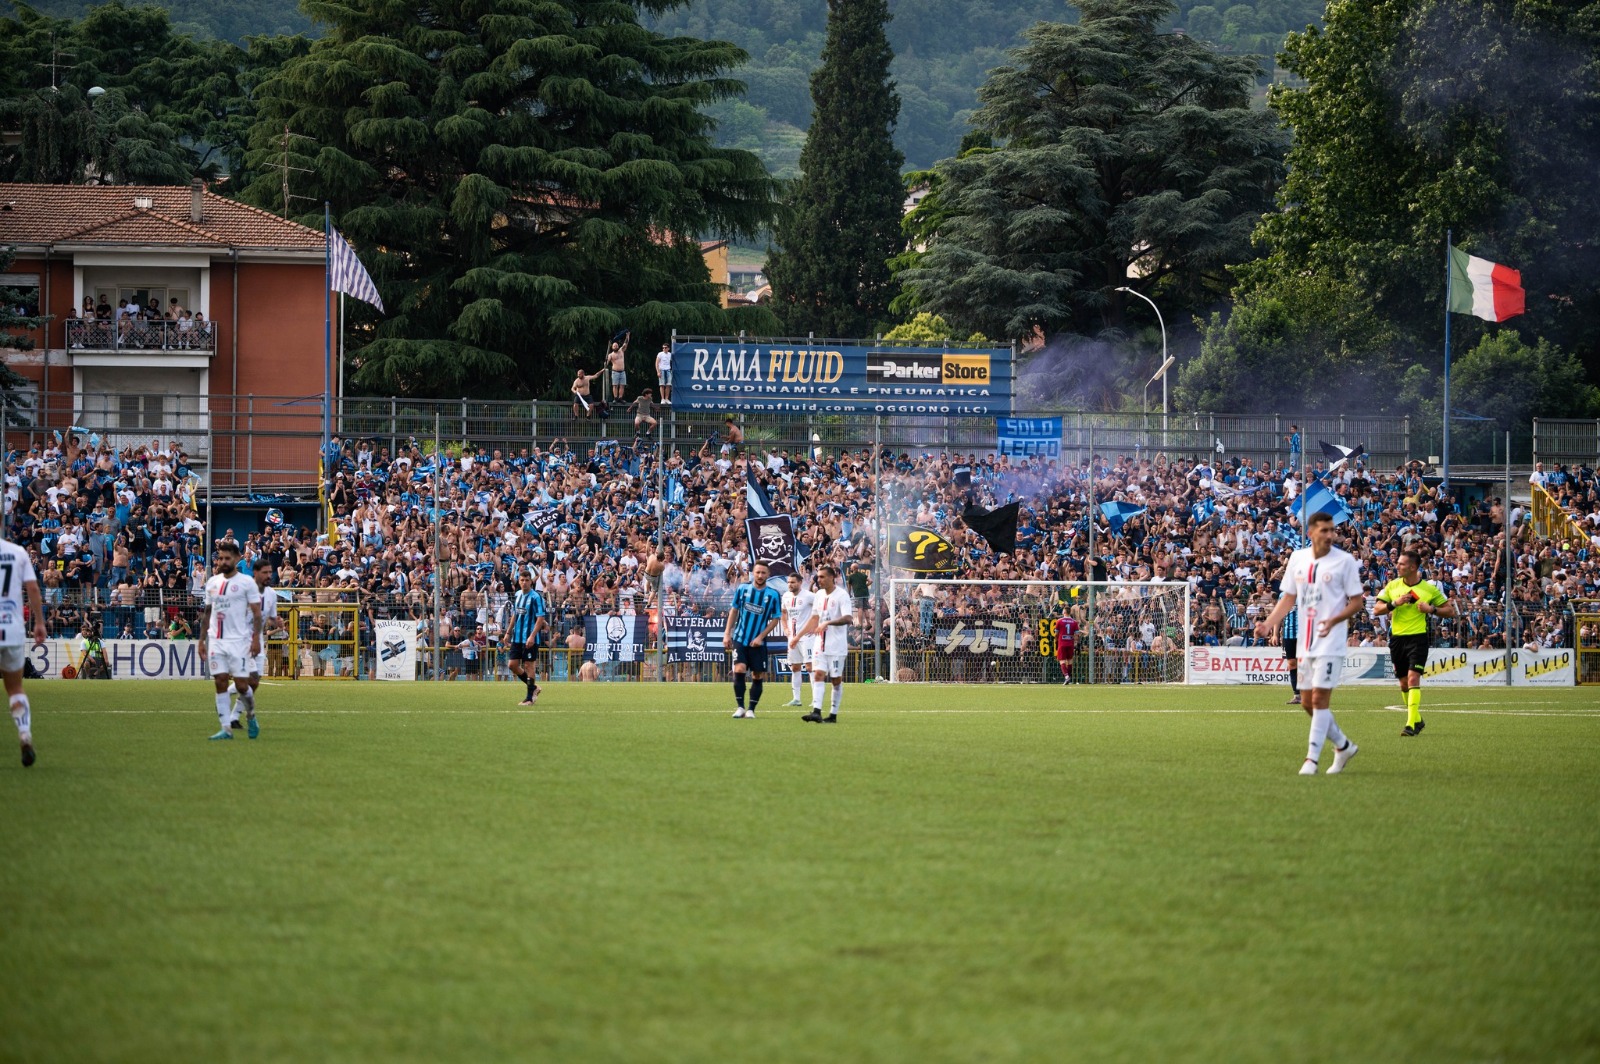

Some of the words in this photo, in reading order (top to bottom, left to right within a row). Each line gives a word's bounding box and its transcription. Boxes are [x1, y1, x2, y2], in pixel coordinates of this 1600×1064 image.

[691, 348, 763, 382] RAMA
[767, 350, 844, 384] FLUID
[883, 361, 940, 378] Parker
[945, 363, 987, 379] Store
[691, 384, 841, 394] OLEODINAMICA
[868, 387, 990, 396] PNEUMATICA
[691, 402, 855, 411] www.ramafluid.com
[875, 405, 950, 413] OGGIONO
[957, 406, 988, 414] (LC)
[1006, 419, 1053, 436] SOLO
[1001, 440, 1059, 457] LECCO
[533, 512, 559, 529] LECCO
[377, 620, 413, 633] BRIGATE
[666, 617, 725, 628] VETERANI
[1065, 623, 1070, 635] 1
[586, 642, 643, 652] DIFFIDATI
[668, 653, 681, 663] AL
[685, 652, 725, 662] SEGUITO
[1343, 658, 1362, 668] ELLI
[1473, 652, 1519, 675] LIVIO
[1525, 652, 1570, 675] LIVIO
[1326, 662, 1333, 675] 3
